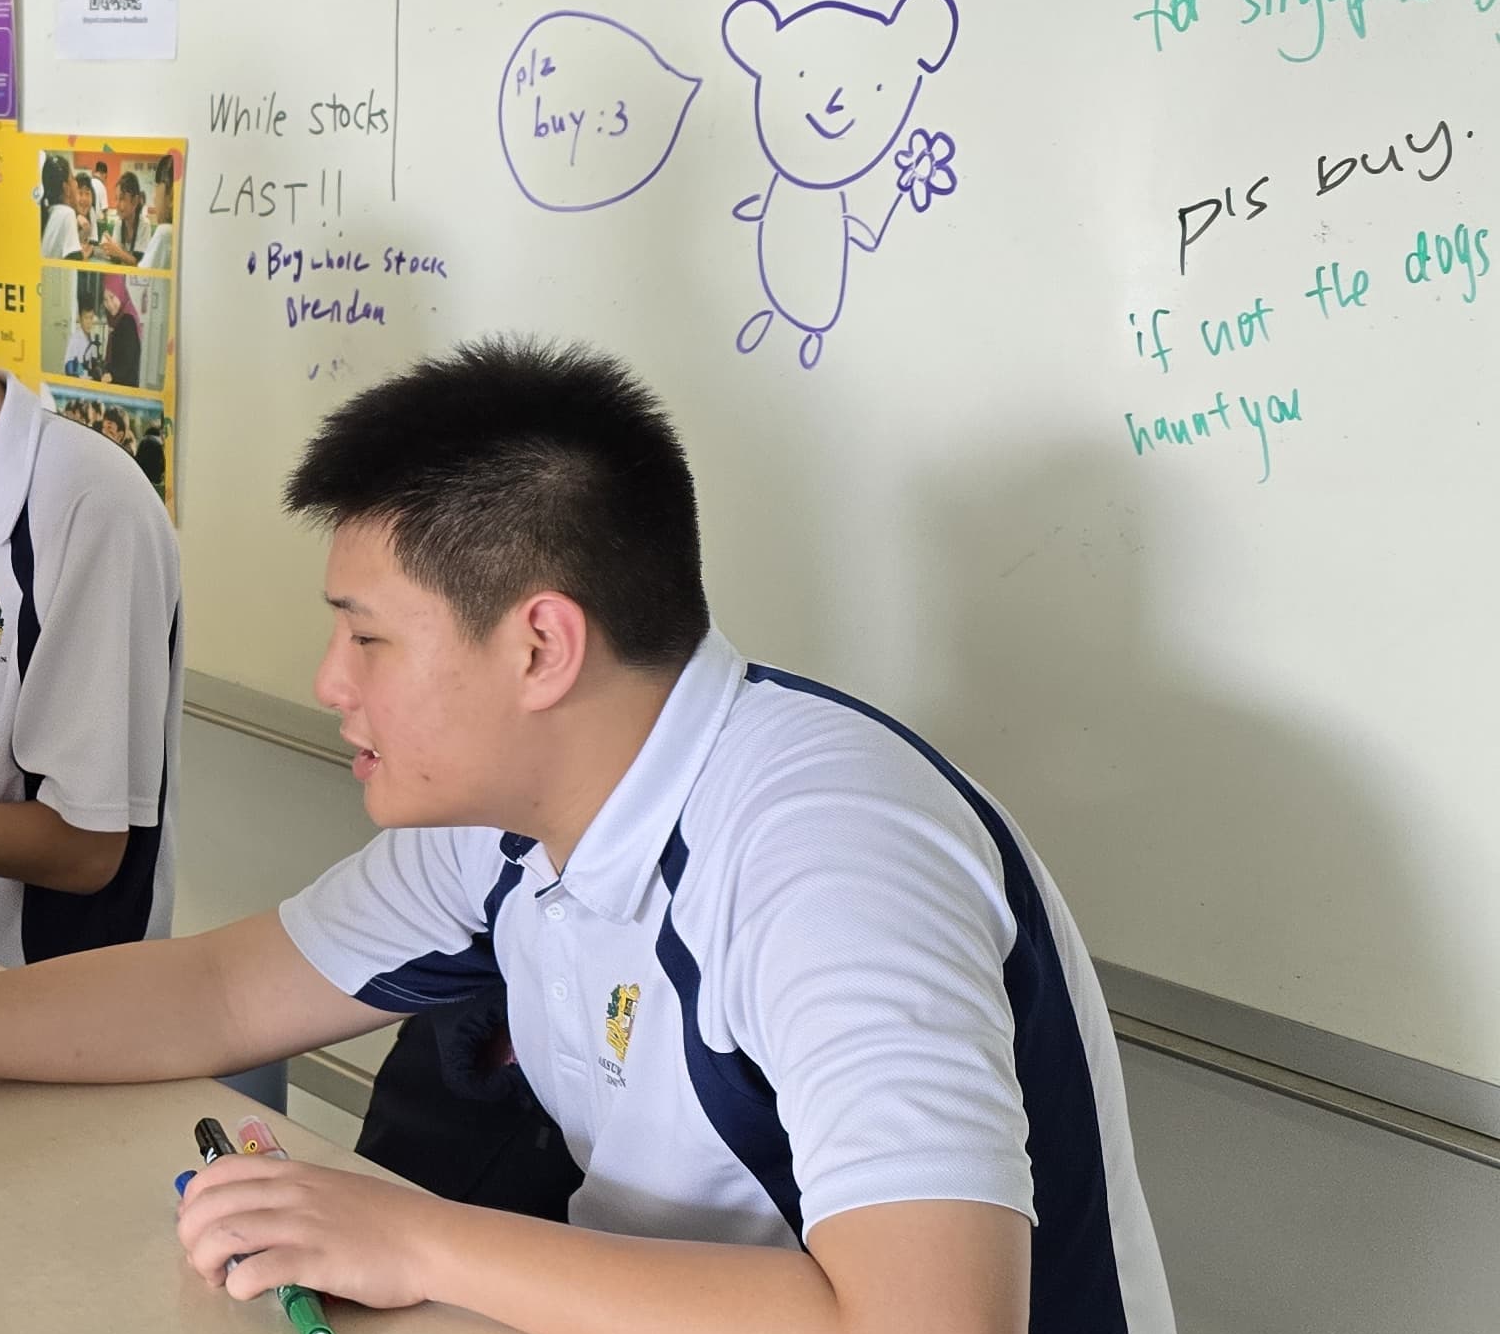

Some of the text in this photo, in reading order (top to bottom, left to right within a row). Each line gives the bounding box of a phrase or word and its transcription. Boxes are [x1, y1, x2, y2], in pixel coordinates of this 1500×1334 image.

[210, 87, 389, 137] While stocks
[534, 94, 586, 167] buy
[267, 242, 304, 283] Buy
[1177, 174, 1270, 275] pls
[1129, 309, 1173, 374] if
[1201, 298, 1275, 356] not
[1405, 223, 1491, 304] dogs
[1239, 387, 1303, 485] you
